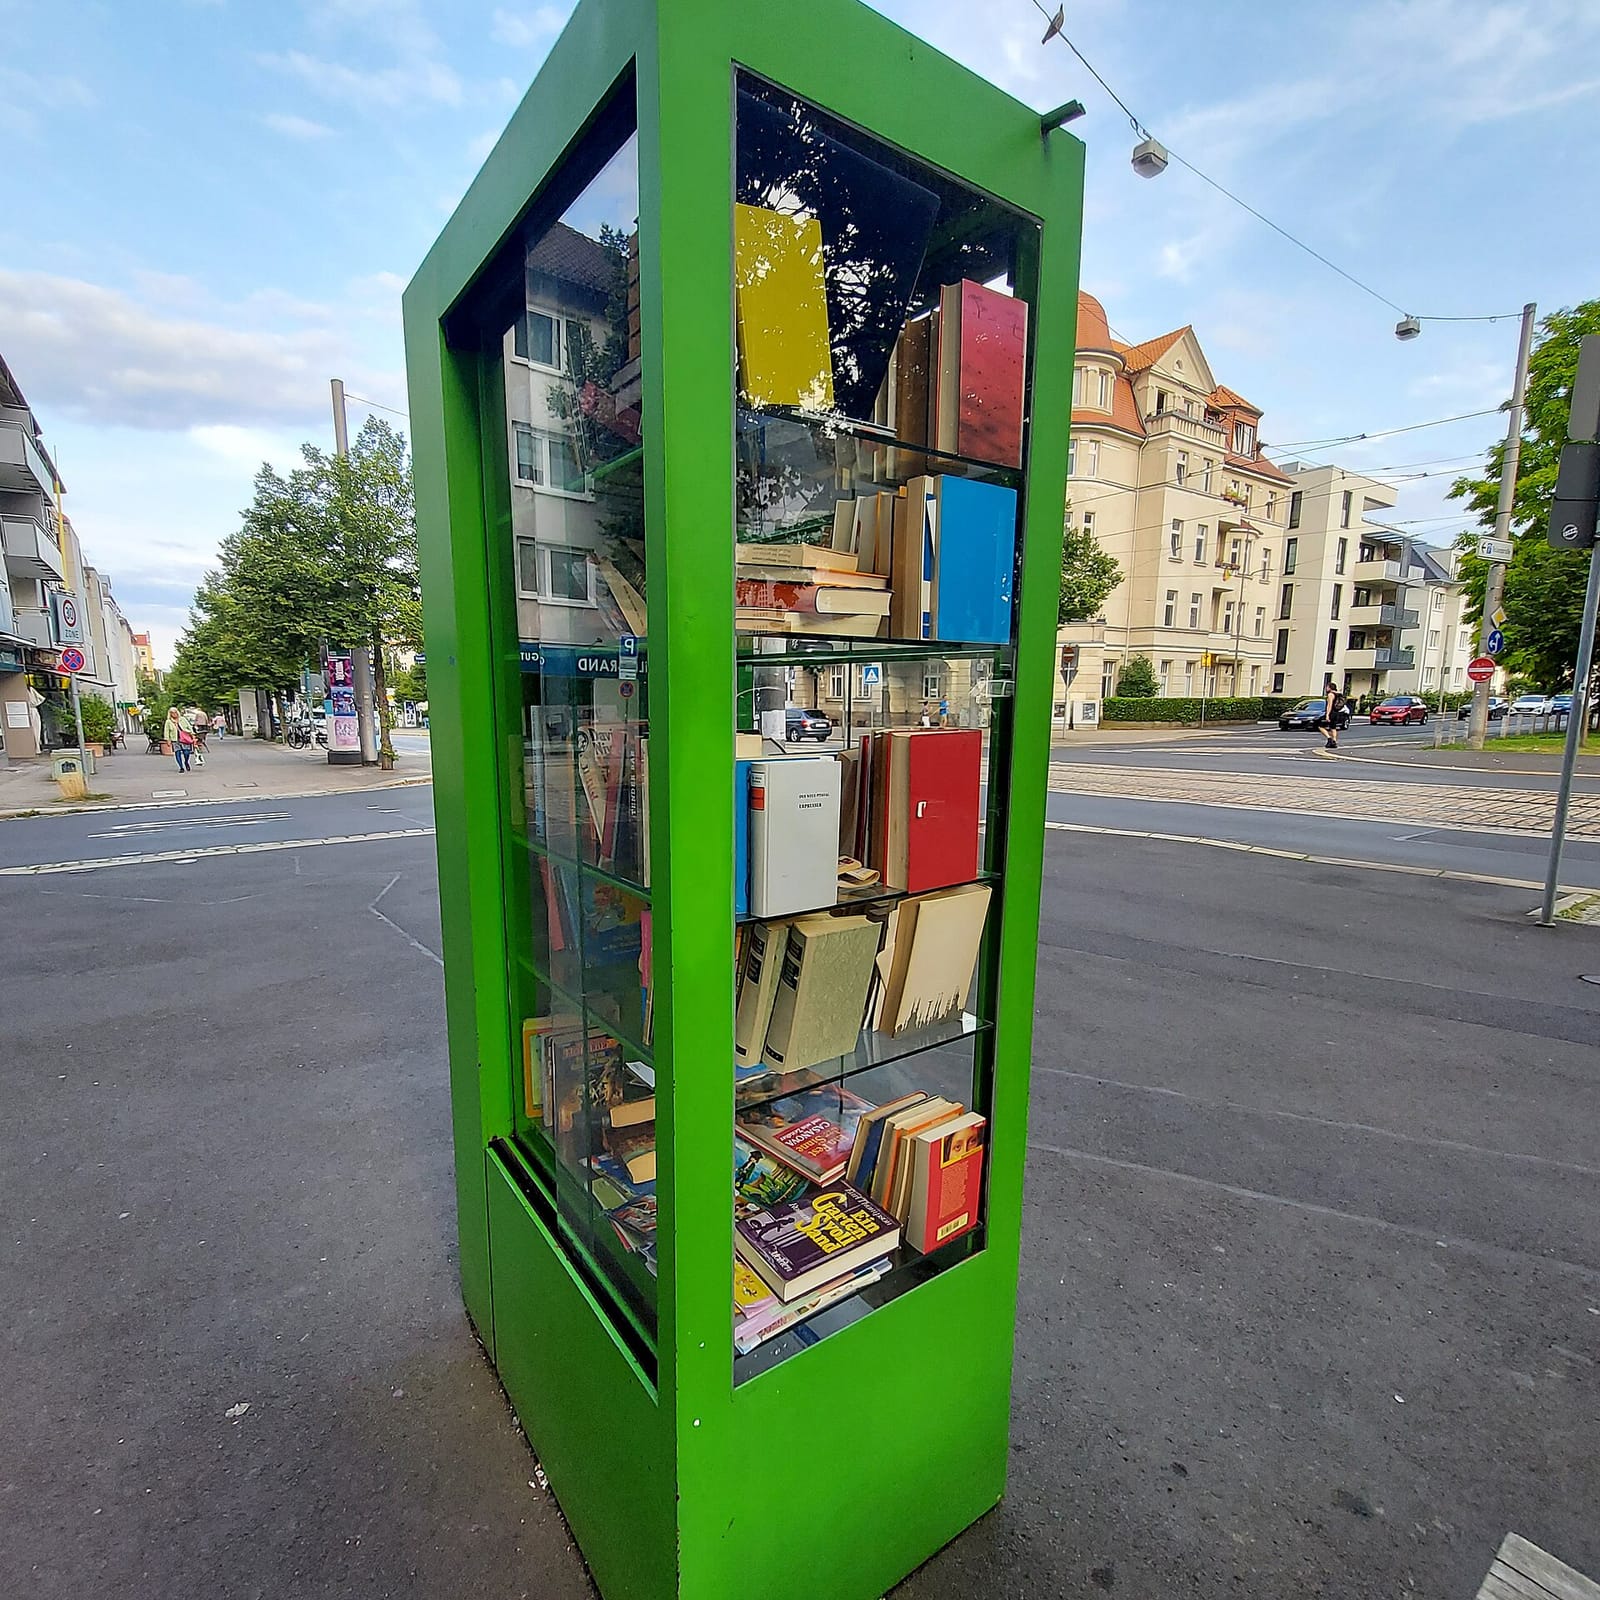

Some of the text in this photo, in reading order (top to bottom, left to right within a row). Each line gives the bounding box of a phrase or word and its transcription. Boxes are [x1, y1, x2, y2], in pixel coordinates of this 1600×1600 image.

[65, 605, 74, 621] 30
[65, 629, 79, 639] ZONE
[785, 1120, 831, 1147] CASANOVA
[795, 1135, 826, 1152] Sinne
[807, 1143, 832, 1157] Fest
[812, 1192, 868, 1240] Garten
[850, 1209, 880, 1234] Ein
[857, 1196, 893, 1226] Thompson
[795, 1212, 842, 1254] Sand
[824, 1221, 857, 1247] voll
